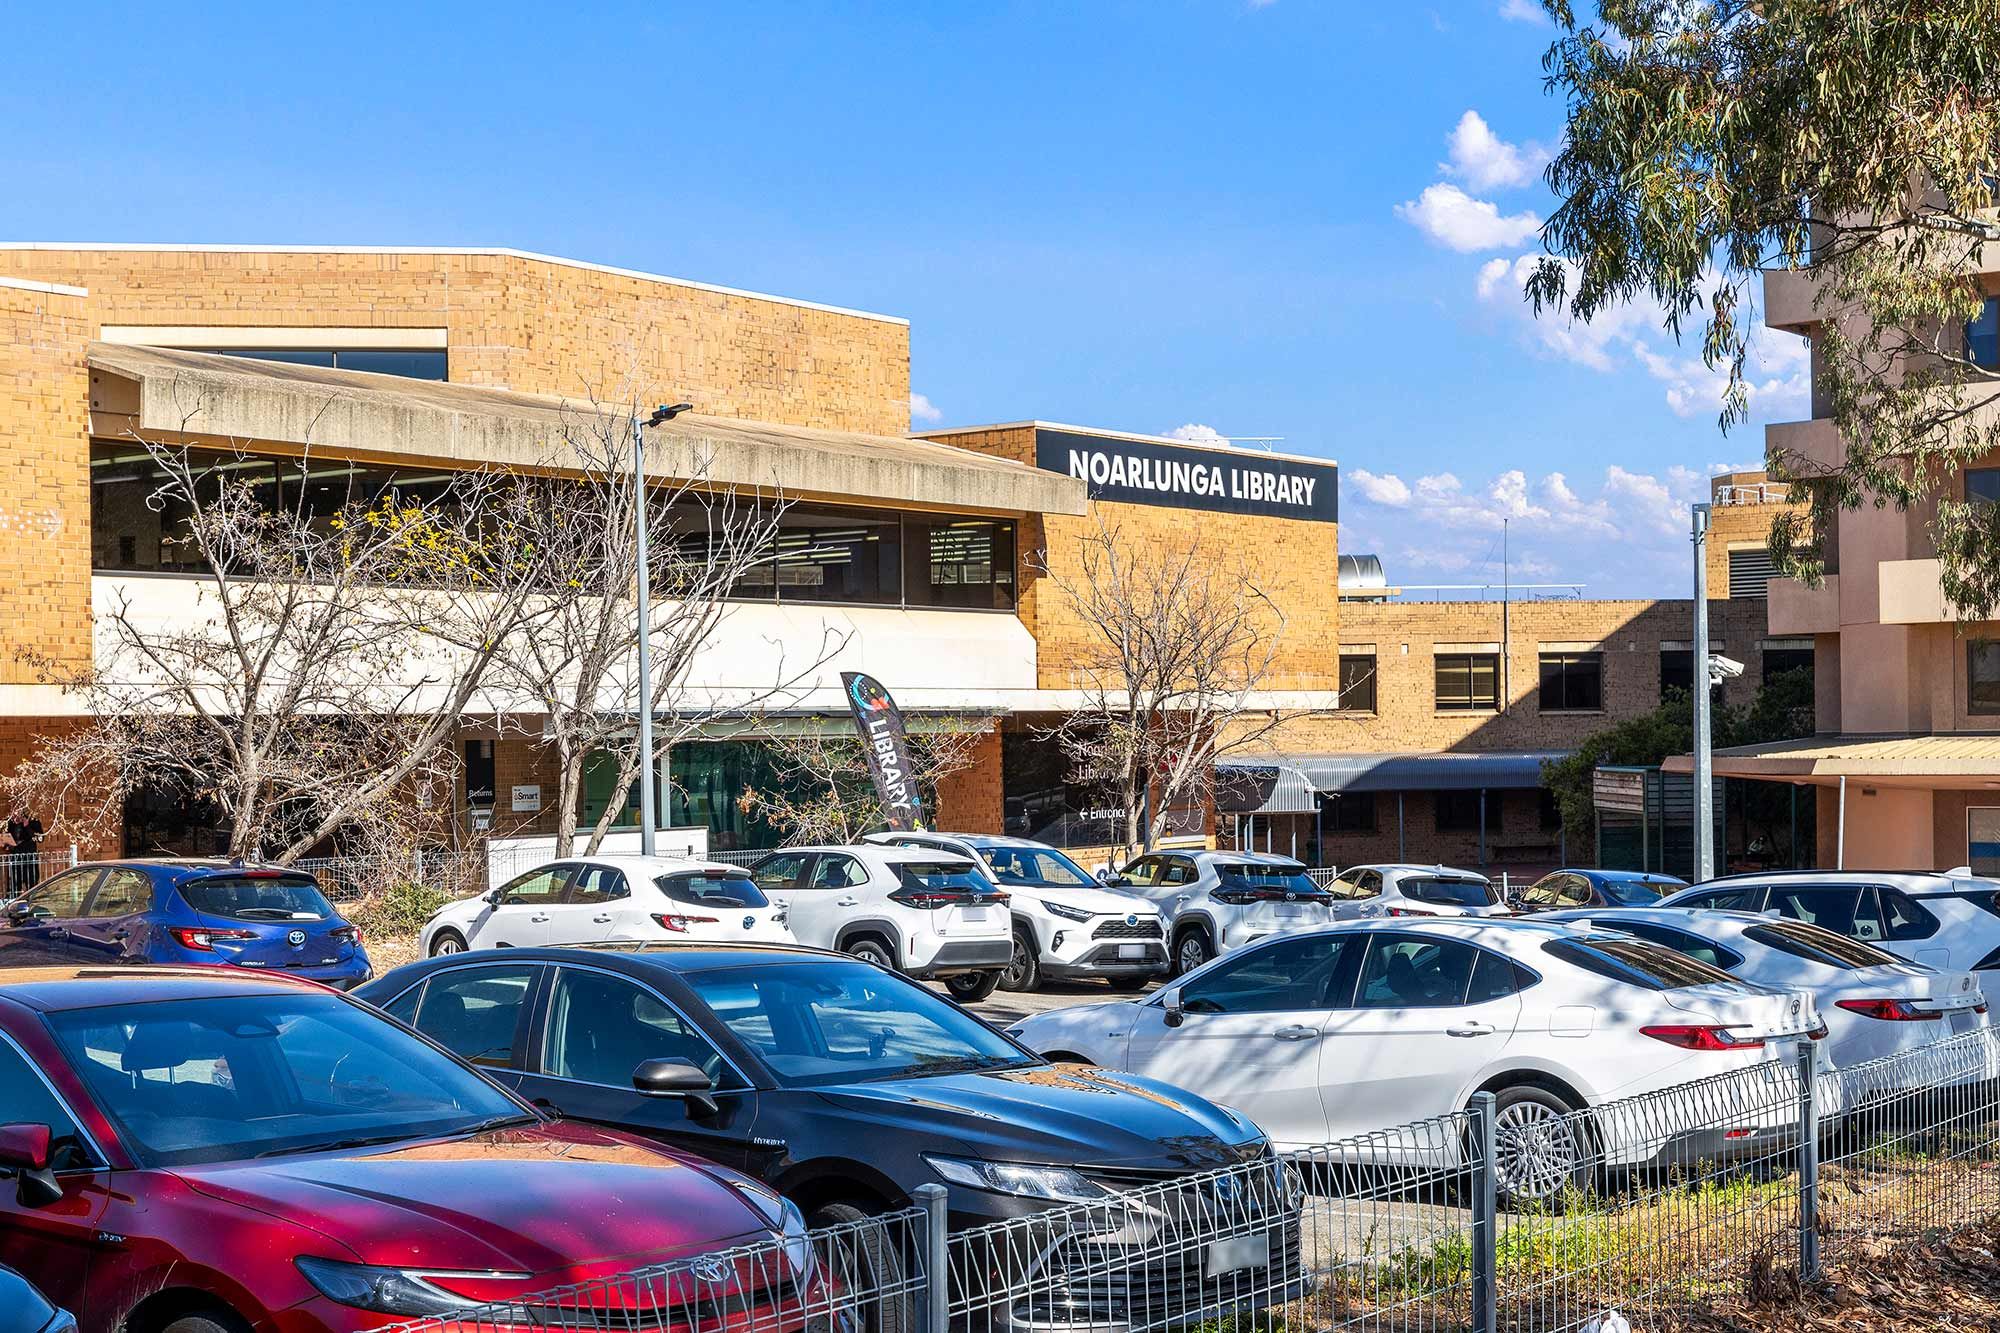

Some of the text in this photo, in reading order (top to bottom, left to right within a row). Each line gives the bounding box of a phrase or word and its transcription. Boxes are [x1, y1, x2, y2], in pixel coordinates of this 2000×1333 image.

[1069, 449, 1317, 506] NOARLUNGA LIBRARY
[468, 789, 493, 797] Returns
[869, 719, 911, 810] LIBRARY
